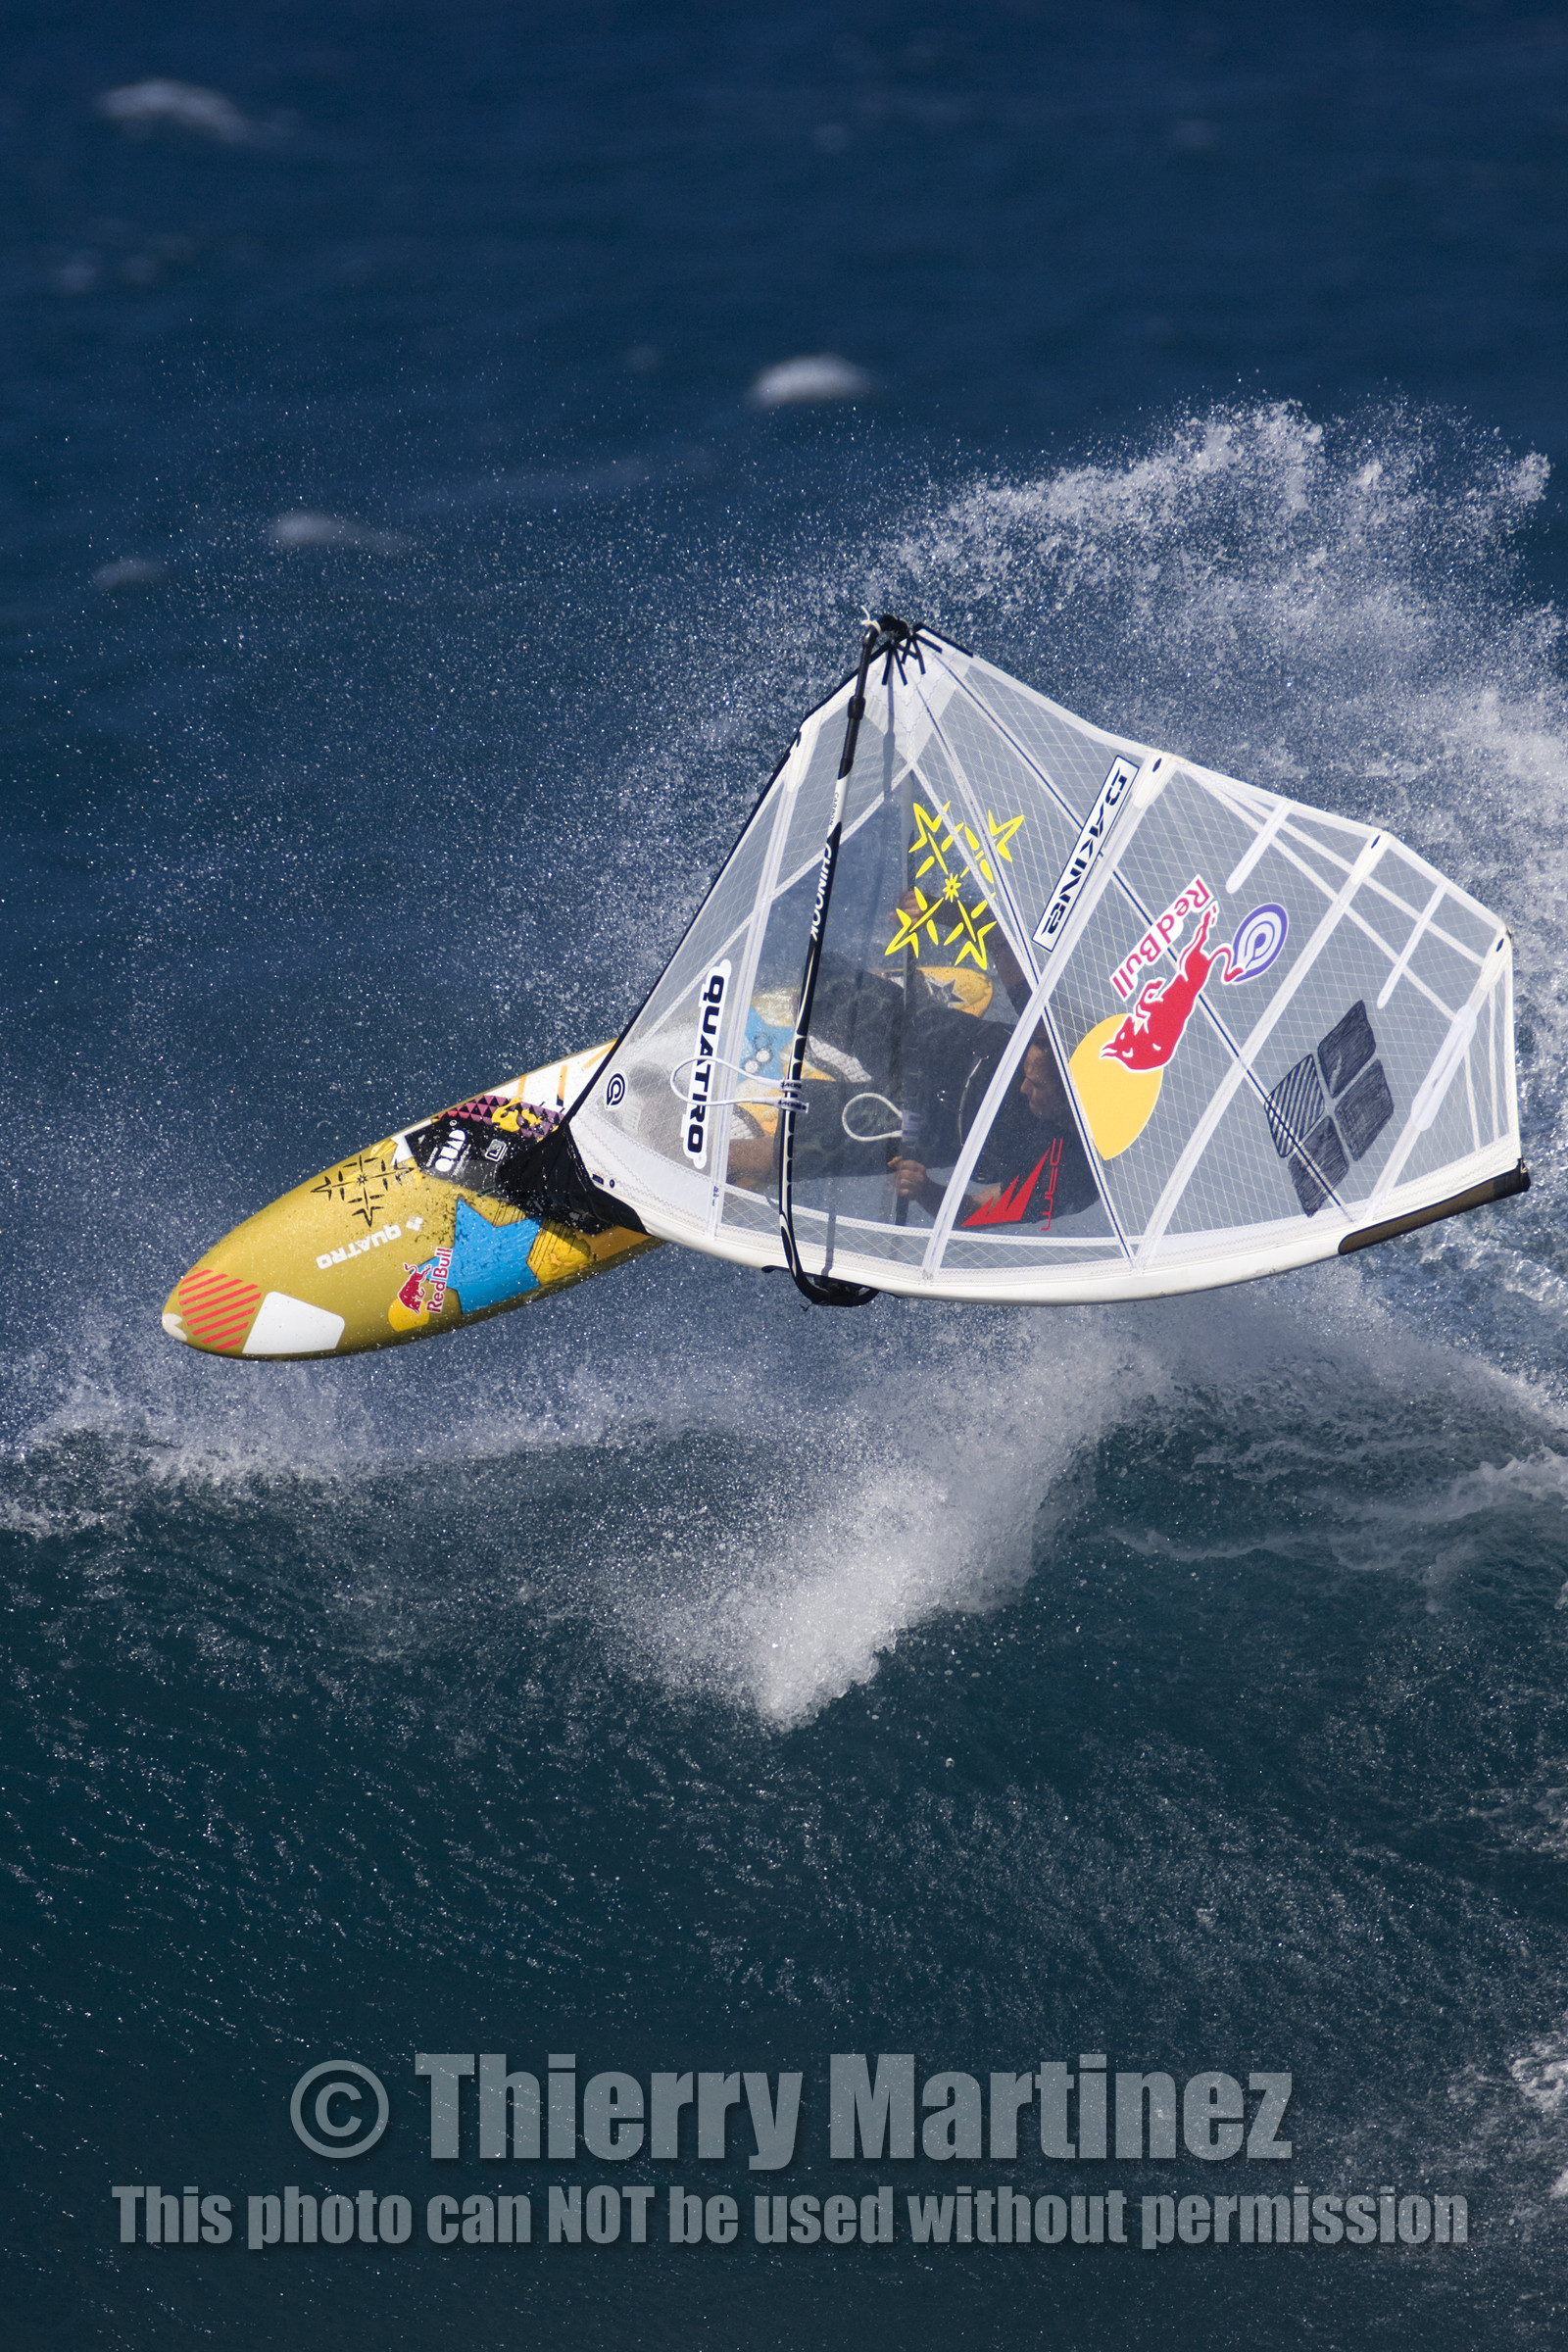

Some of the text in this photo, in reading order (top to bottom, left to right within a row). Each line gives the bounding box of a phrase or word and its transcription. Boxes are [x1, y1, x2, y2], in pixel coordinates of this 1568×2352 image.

[809, 842, 833, 942] CHINOOK
[1041, 767, 1128, 936] DAKINE
[1112, 878, 1210, 999] Red Bull
[687, 975, 725, 1153] QUATRO
[434, 1129, 466, 1172] QUAD
[316, 1224, 402, 1270] QUATRO
[426, 1248, 453, 1313] Red Bull
